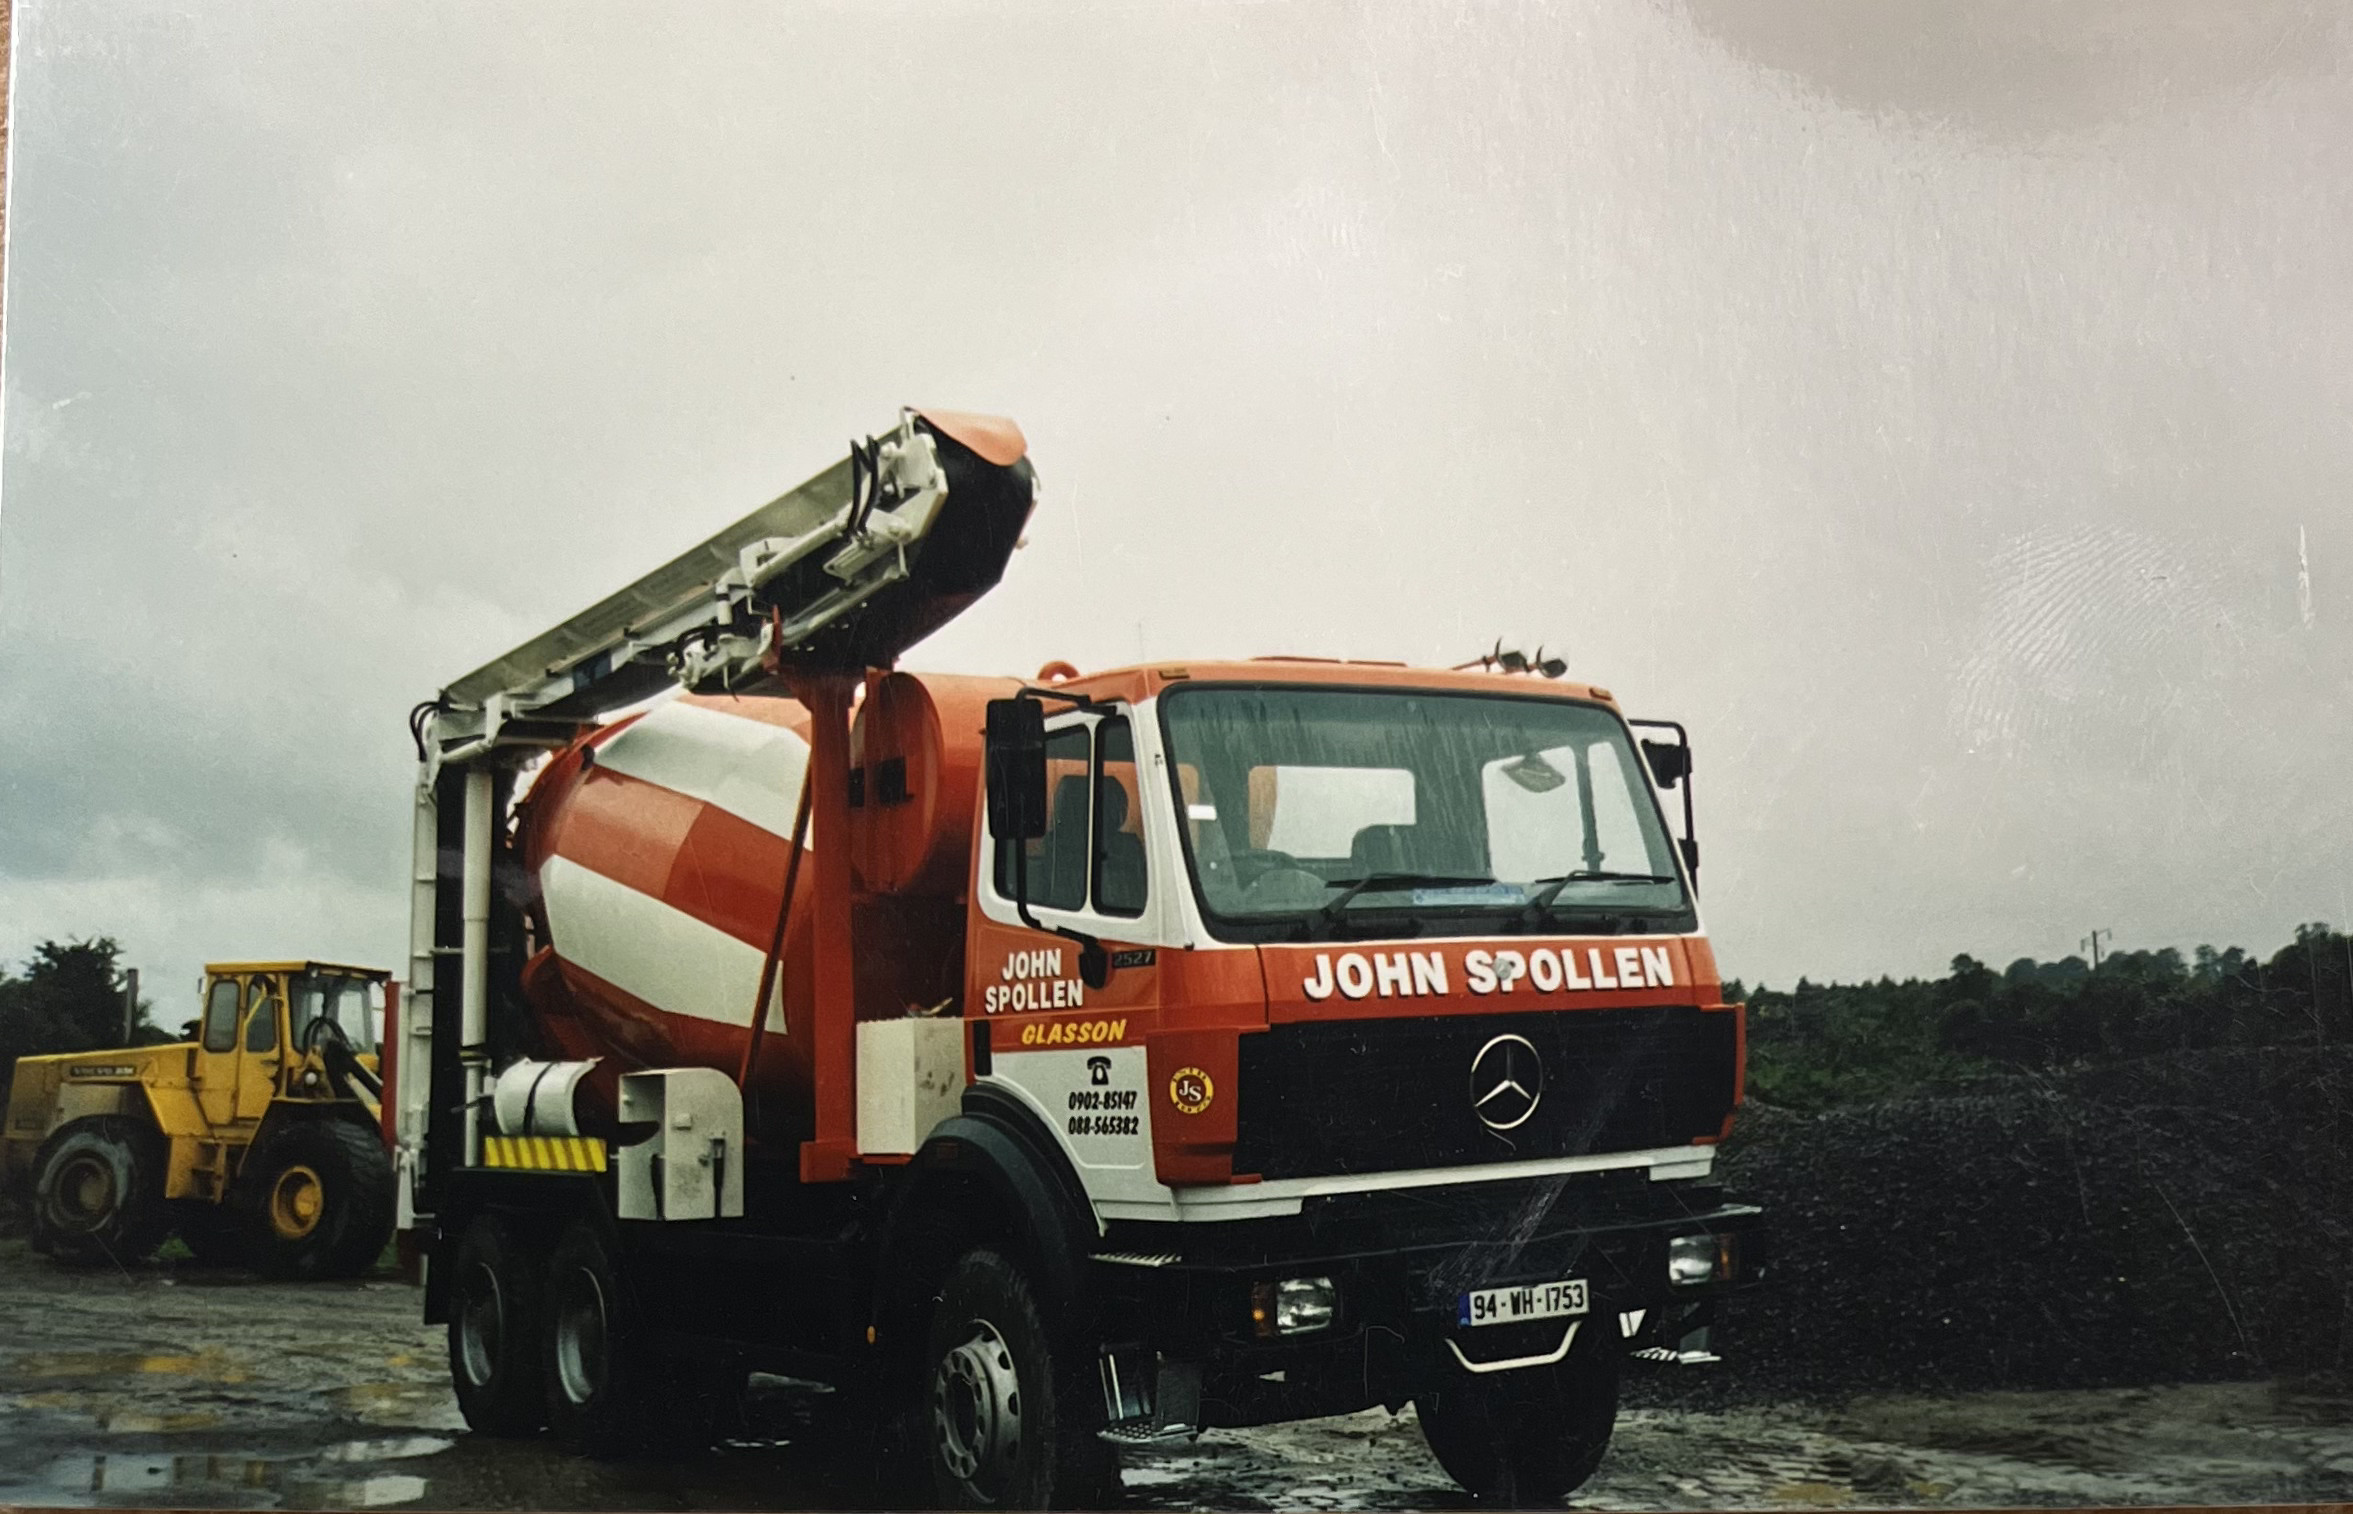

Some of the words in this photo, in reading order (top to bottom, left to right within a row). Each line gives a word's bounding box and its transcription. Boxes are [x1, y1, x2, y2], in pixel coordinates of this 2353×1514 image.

[1002, 948, 1062, 981] JOHN
[1114, 951, 1153, 966] 2527
[1303, 951, 1449, 999] JOHN
[1465, 946, 1674, 995] SPOLLEN
[985, 979, 1084, 1013] SPOLLEN
[1021, 1018, 1127, 1045] GLASSON
[1068, 1090, 1138, 1110] 0902-85147
[1068, 1116, 1139, 1135] 088-565382
